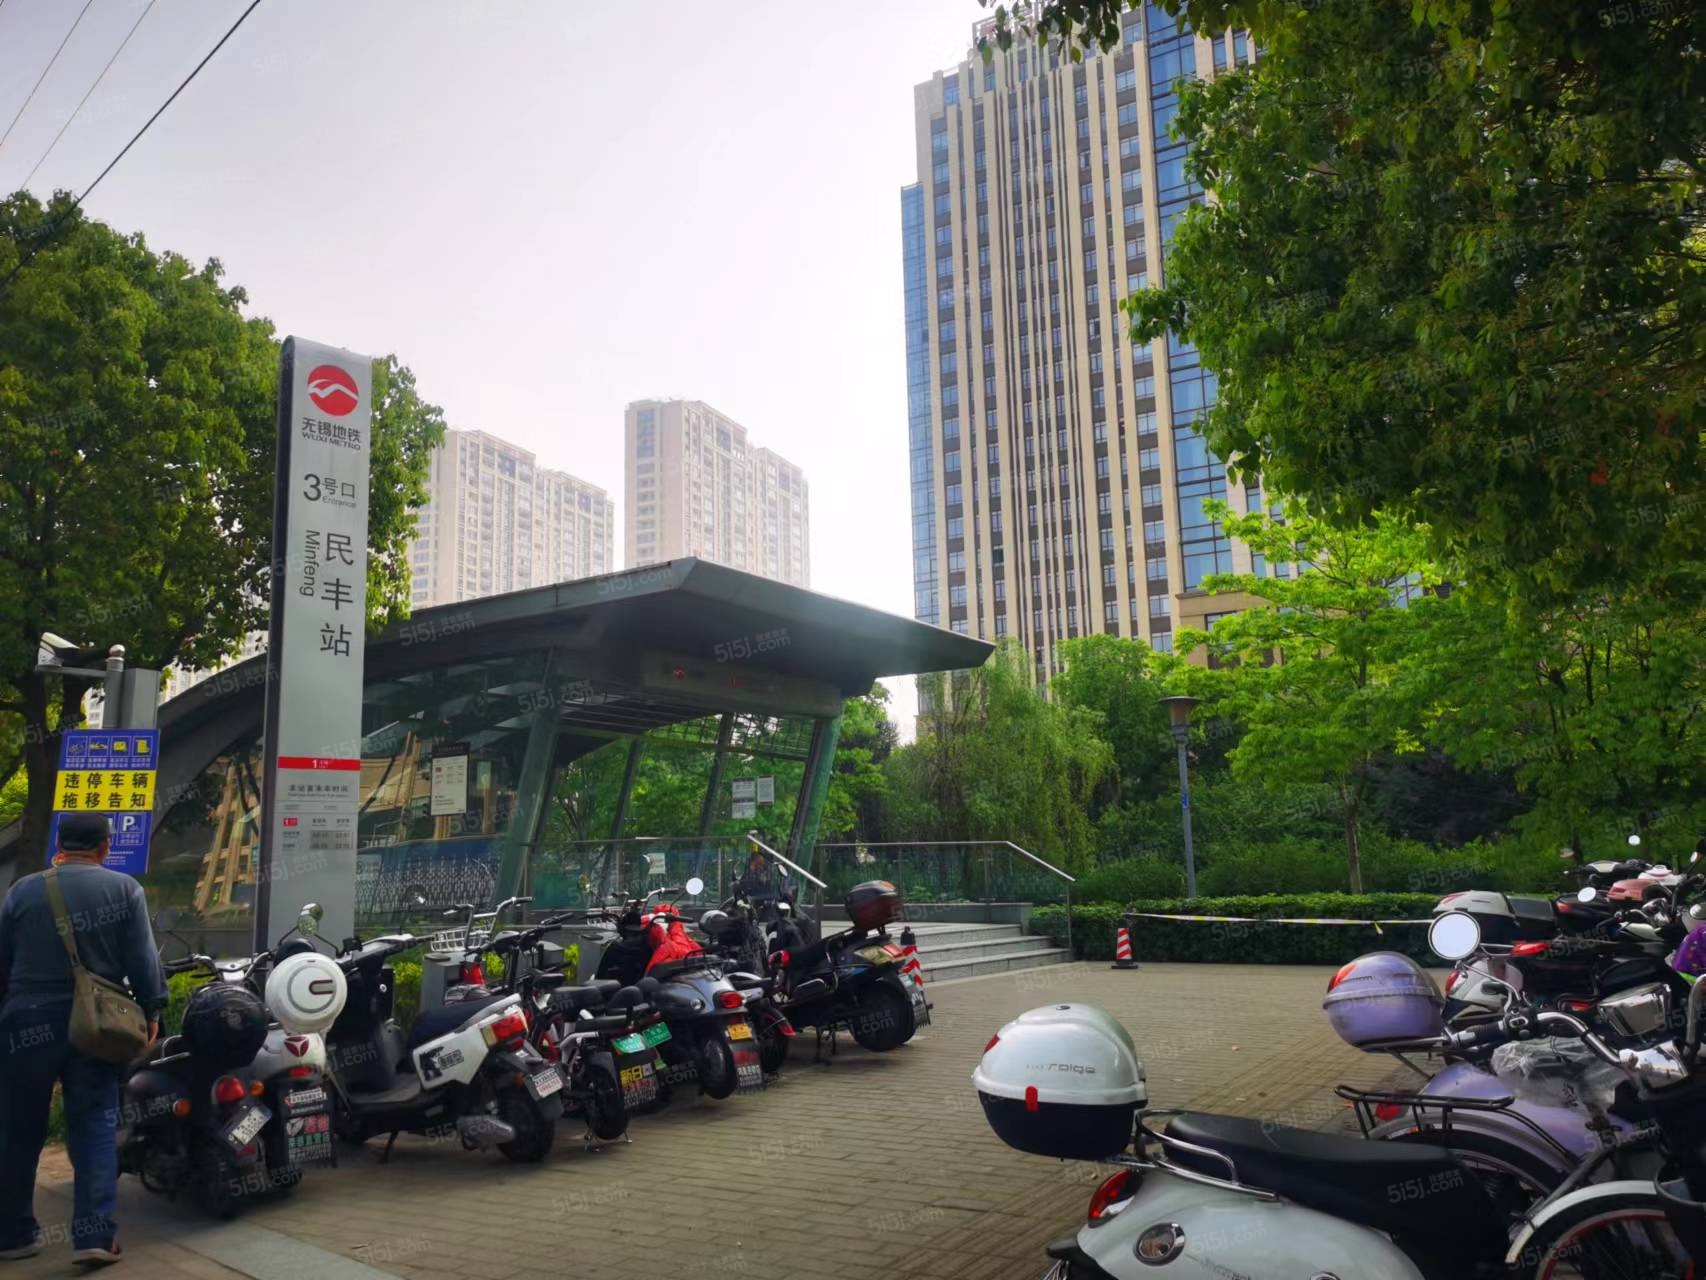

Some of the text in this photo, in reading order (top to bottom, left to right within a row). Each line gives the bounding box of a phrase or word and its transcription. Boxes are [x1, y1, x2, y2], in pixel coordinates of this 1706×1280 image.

[302, 417, 360, 443] 无锡地铁
[302, 431, 361, 450] WUXI METRO
[304, 473, 355, 501] 3号口
[300, 529, 320, 597] Minfeng
[320, 532, 354, 657] 民丰站
[63, 773, 148, 789] 违停车辆
[61, 792, 146, 809] 拖移告知
[122, 815, 135, 831] P
